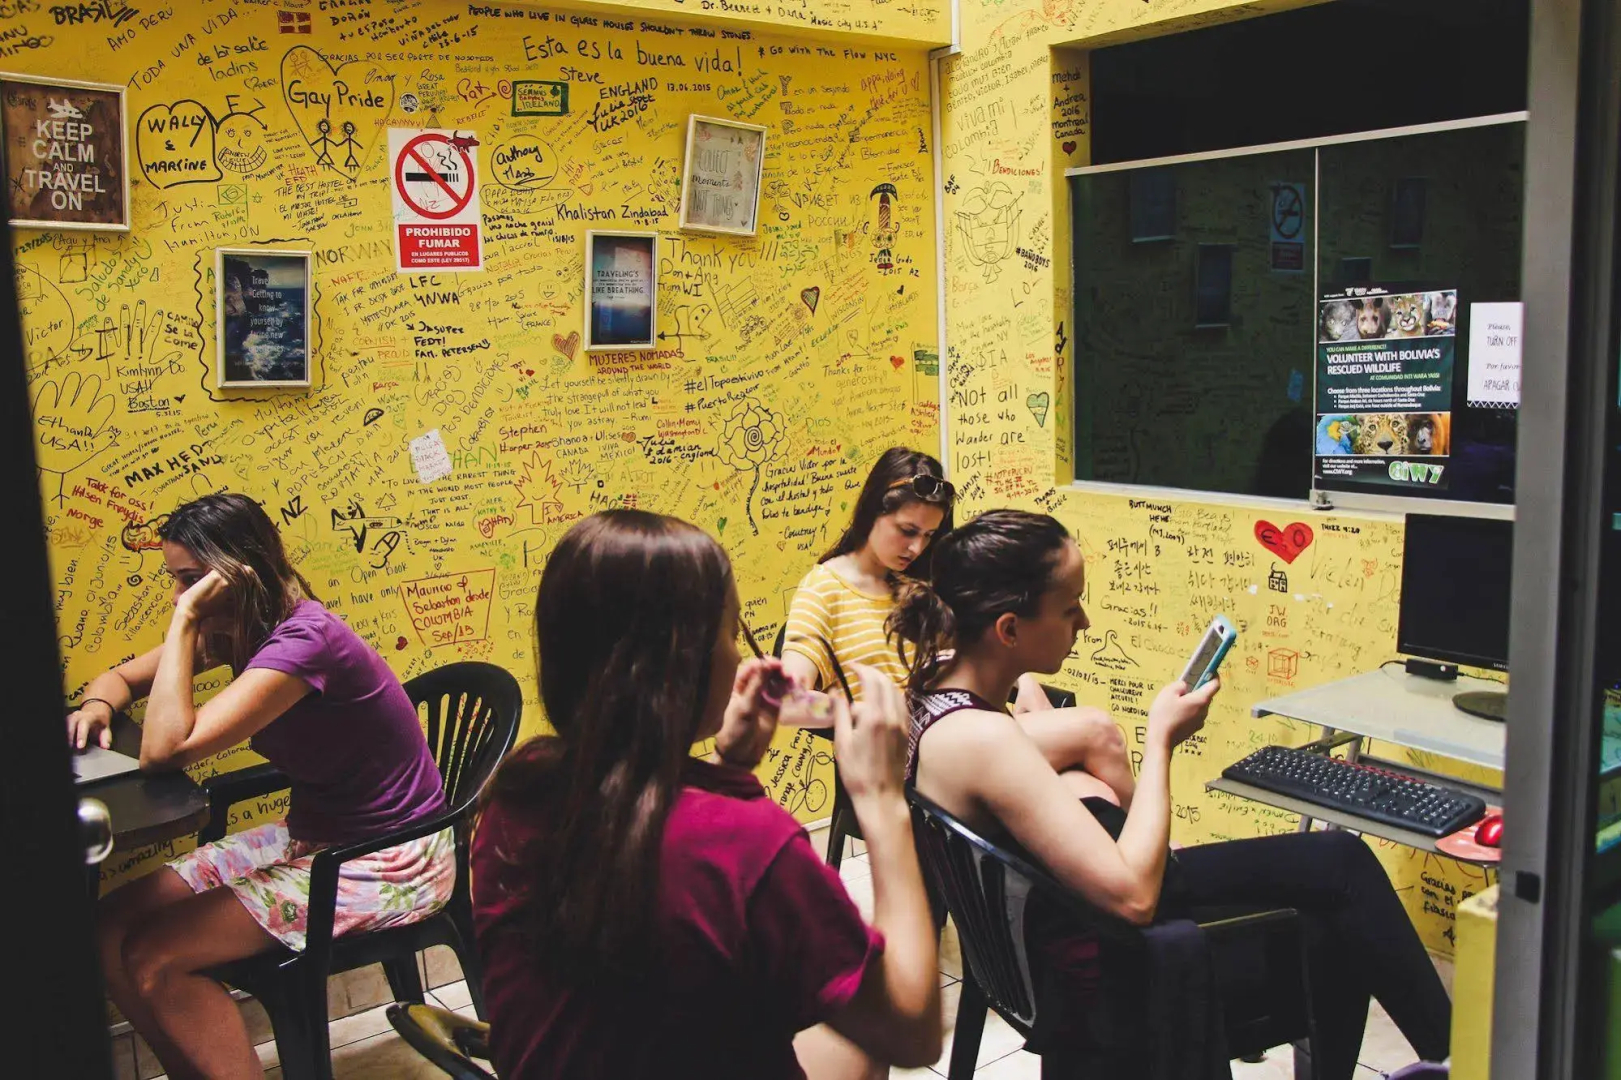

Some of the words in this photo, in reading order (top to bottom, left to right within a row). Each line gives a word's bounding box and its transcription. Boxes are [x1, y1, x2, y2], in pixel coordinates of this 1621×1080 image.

[468, 5, 501, 17] PEOPLE
[504, 10, 524, 18] WHO
[528, 11, 549, 21] LIVE
[555, 14, 565, 22] IN
[603, 20, 634, 31] HOUSES
[107, 29, 136, 51] AMO
[139, 8, 174, 31] PERU
[127, 59, 166, 91] TODA
[171, 33, 196, 58] UNA
[366, 52, 383, 61] POR
[387, 53, 405, 61] SER
[407, 53, 434, 61] PARTE
[522, 35, 569, 62] Esta
[577, 39, 600, 59] es
[608, 41, 624, 61] la
[636, 39, 686, 67] buena
[694, 46, 743, 77] vida!
[559, 67, 605, 84] Steve
[600, 77, 658, 99] ENGLAND
[667, 83, 711, 92] 13.06.2015
[288, 80, 331, 118] Gay
[332, 80, 385, 108] Pride
[1061, 106, 1081, 117] 2016
[37, 119, 93, 142] KEEP
[148, 115, 207, 147] WALLY
[32, 139, 95, 163] CALM
[53, 162, 74, 173] AND
[25, 169, 106, 193] TRAVEL
[275, 186, 293, 197] THE
[295, 182, 315, 194] BEST
[51, 190, 83, 210] ON
[556, 203, 616, 222] Khalistan
[621, 205, 669, 219] Zindabad
[239, 225, 260, 238] ON
[405, 227, 471, 237] PROHIBIDO
[418, 239, 460, 248] FUMAR
[316, 240, 393, 269] NORWAY
[665, 237, 725, 268] Thank
[597, 270, 639, 278] TRAVELING'S
[409, 275, 441, 290] LFC
[592, 286, 605, 294] LIKE
[414, 292, 460, 307] YNWA
[414, 336, 446, 347] FEDT!
[1487, 337, 1504, 346] TURN
[1506, 336, 1517, 346] OFF
[442, 342, 482, 357] PETERSEN
[1326, 352, 1374, 364] VOLUNTEER
[1374, 351, 1398, 362] WITH
[1399, 348, 1441, 360] BOLIVIA'S
[589, 352, 637, 367] MUJERES
[639, 349, 685, 362] NOMADAS
[597, 367, 629, 376] AROUND
[630, 364, 645, 372] THE
[647, 362, 672, 371] WORLD
[1327, 364, 1364, 375] RESCUED
[1364, 362, 1402, 374] WILDLIFE
[539, 375, 560, 391] Let
[564, 376, 597, 393] yourself
[1327, 387, 1345, 395] Choose
[1483, 380, 1510, 391] APAGAR
[611, 388, 621, 397] of
[622, 389, 643, 398] what
[645, 389, 660, 398] you
[958, 386, 987, 408] Not
[997, 383, 1018, 402] all
[127, 396, 170, 410] Boston
[542, 404, 562, 418] truly
[565, 404, 580, 415] love
[599, 402, 615, 414] will
[616, 401, 631, 411] not
[958, 411, 991, 426] those
[997, 408, 1016, 422] who
[499, 425, 547, 442] Stephen
[955, 430, 994, 446] Wander
[1000, 431, 1026, 445] are
[500, 441, 534, 454] Harper
[556, 448, 589, 460] CANADA
[956, 450, 992, 473] lost!
[125, 462, 165, 488] MAX
[457, 471, 487, 481] RAREST
[109, 486, 127, 499] for
[464, 482, 483, 490] MOST
[487, 480, 514, 489] PEOPLE
[280, 495, 307, 526] NZ
[66, 508, 104, 530] Norge
[350, 566, 377, 584] Open
[351, 592, 375, 606] have
[465, 589, 490, 602] desde
[1266, 615, 1287, 628] ORG
